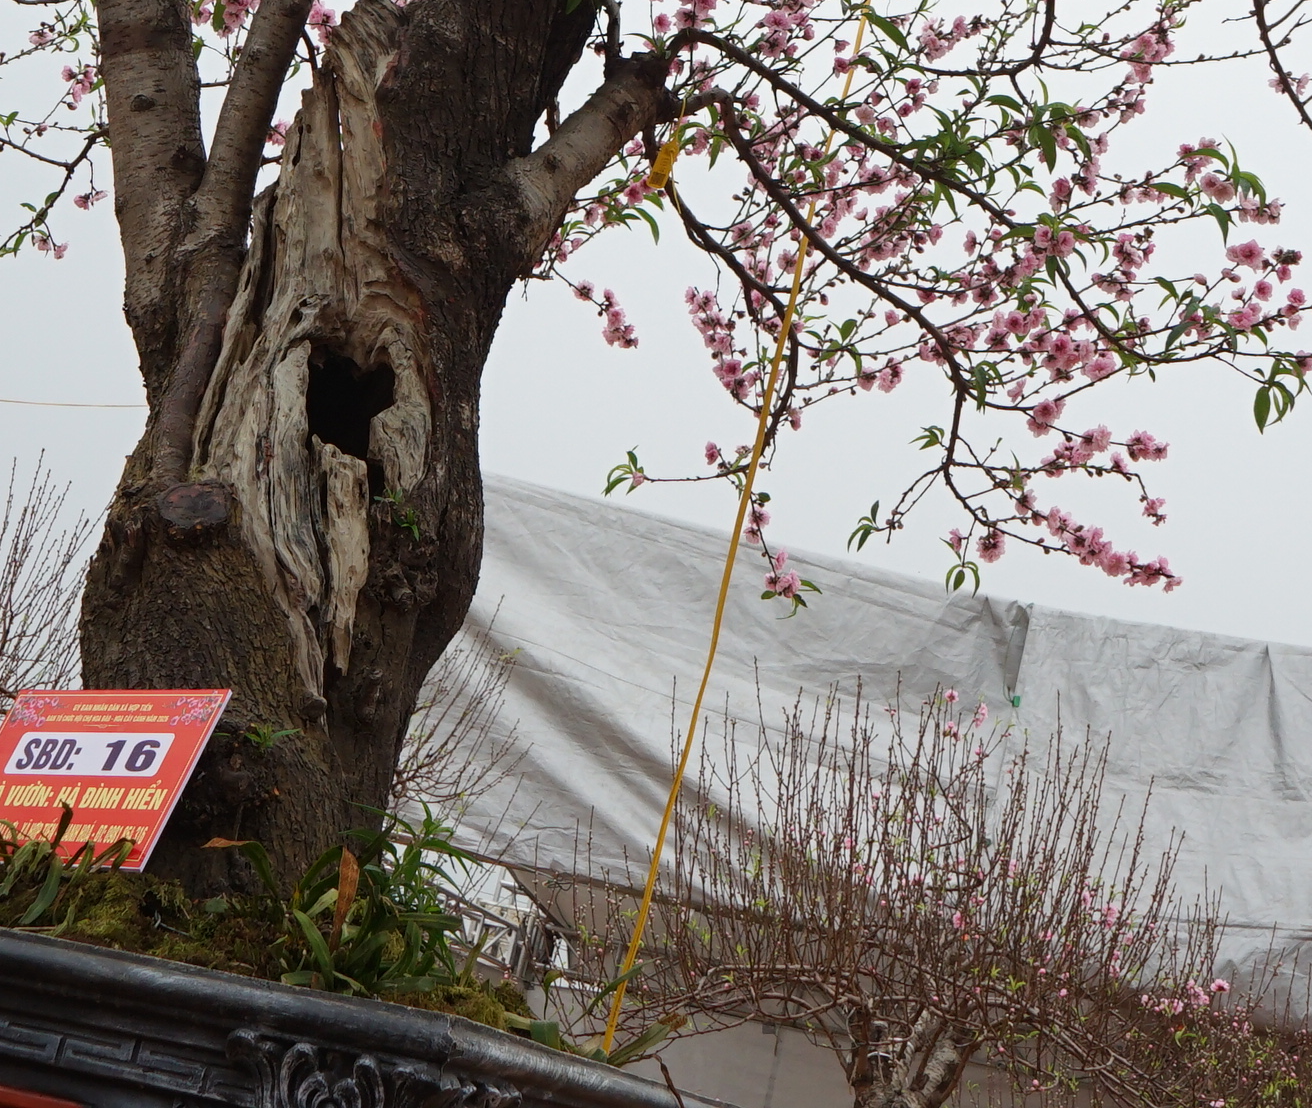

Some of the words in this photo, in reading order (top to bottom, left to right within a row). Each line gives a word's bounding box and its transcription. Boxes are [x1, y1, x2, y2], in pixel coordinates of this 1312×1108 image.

[15, 738, 83, 770] SBD:
[101, 739, 161, 772] 16
[4, 780, 54, 807] VƯỜN:
[78, 782, 125, 809] ĐÌNH
[121, 780, 168, 810] HIỂN
